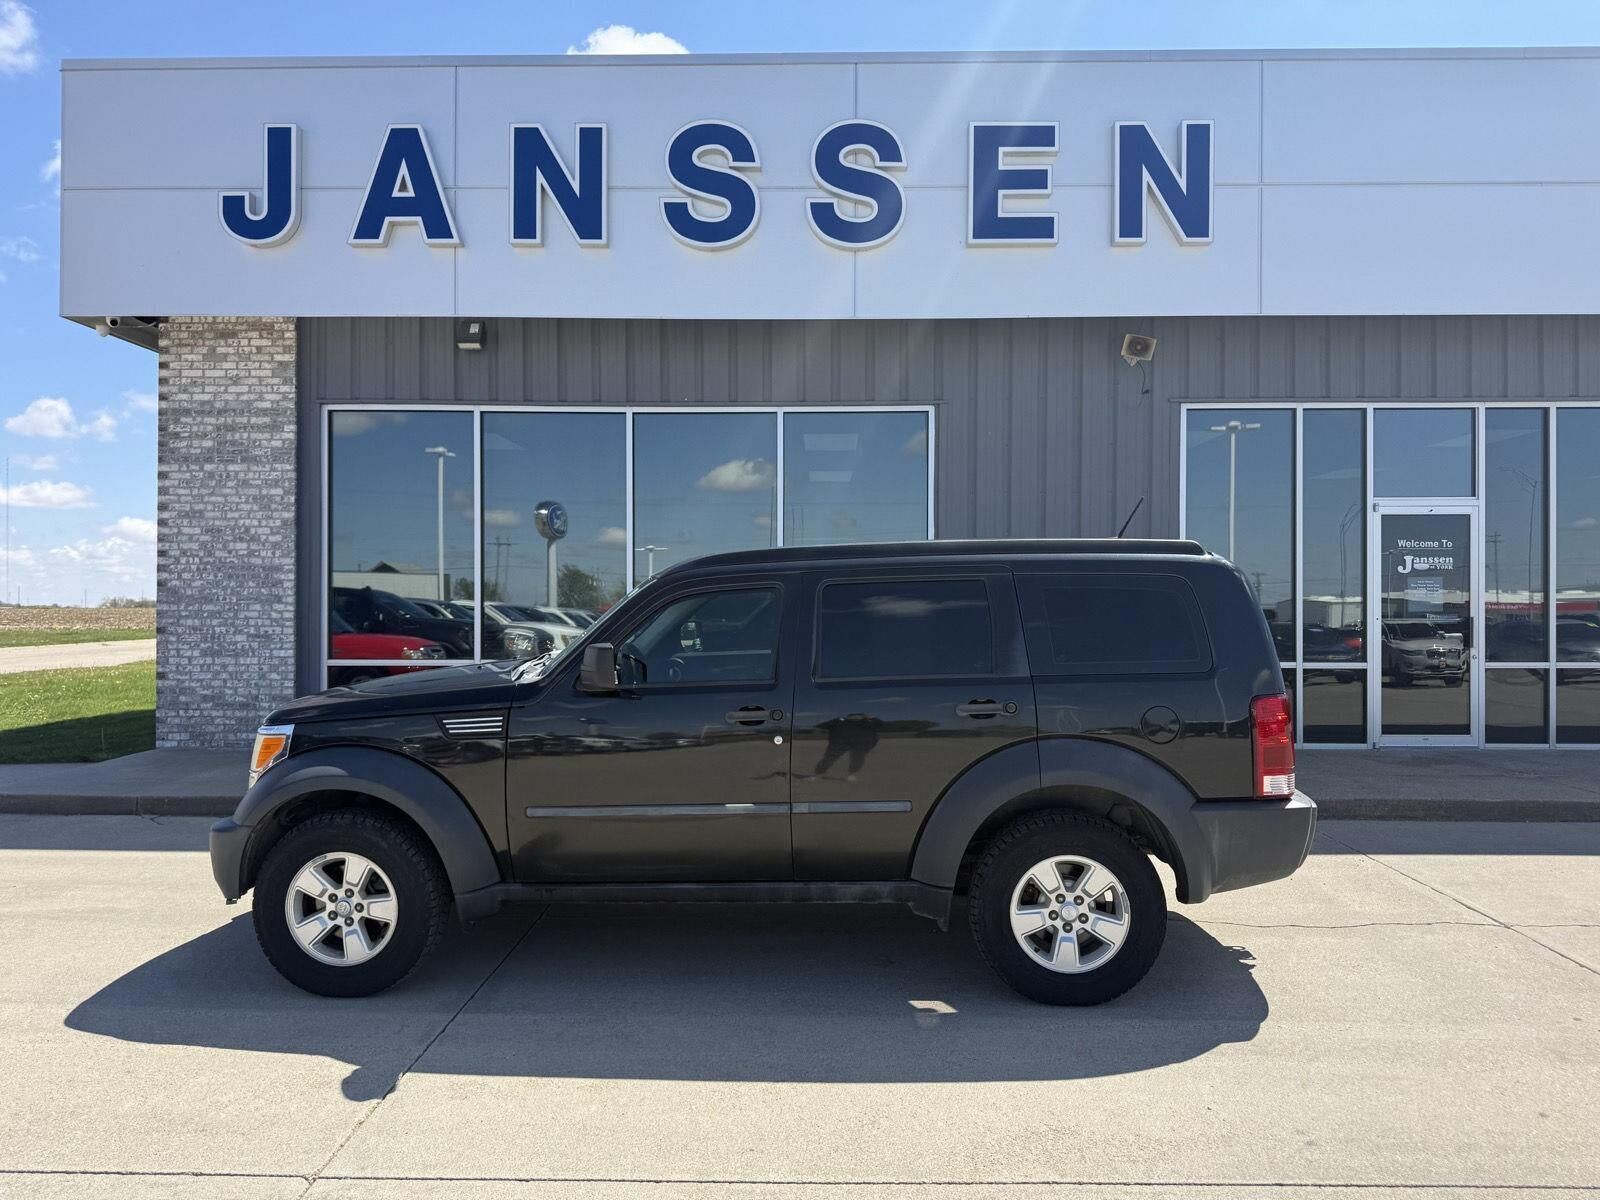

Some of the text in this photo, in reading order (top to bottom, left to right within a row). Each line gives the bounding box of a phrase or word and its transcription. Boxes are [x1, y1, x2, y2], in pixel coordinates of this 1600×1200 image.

[217, 118, 1215, 249] JANSSEN
[1397, 539, 1453, 548] Welcome To
[1397, 555, 1454, 574] Janssen
